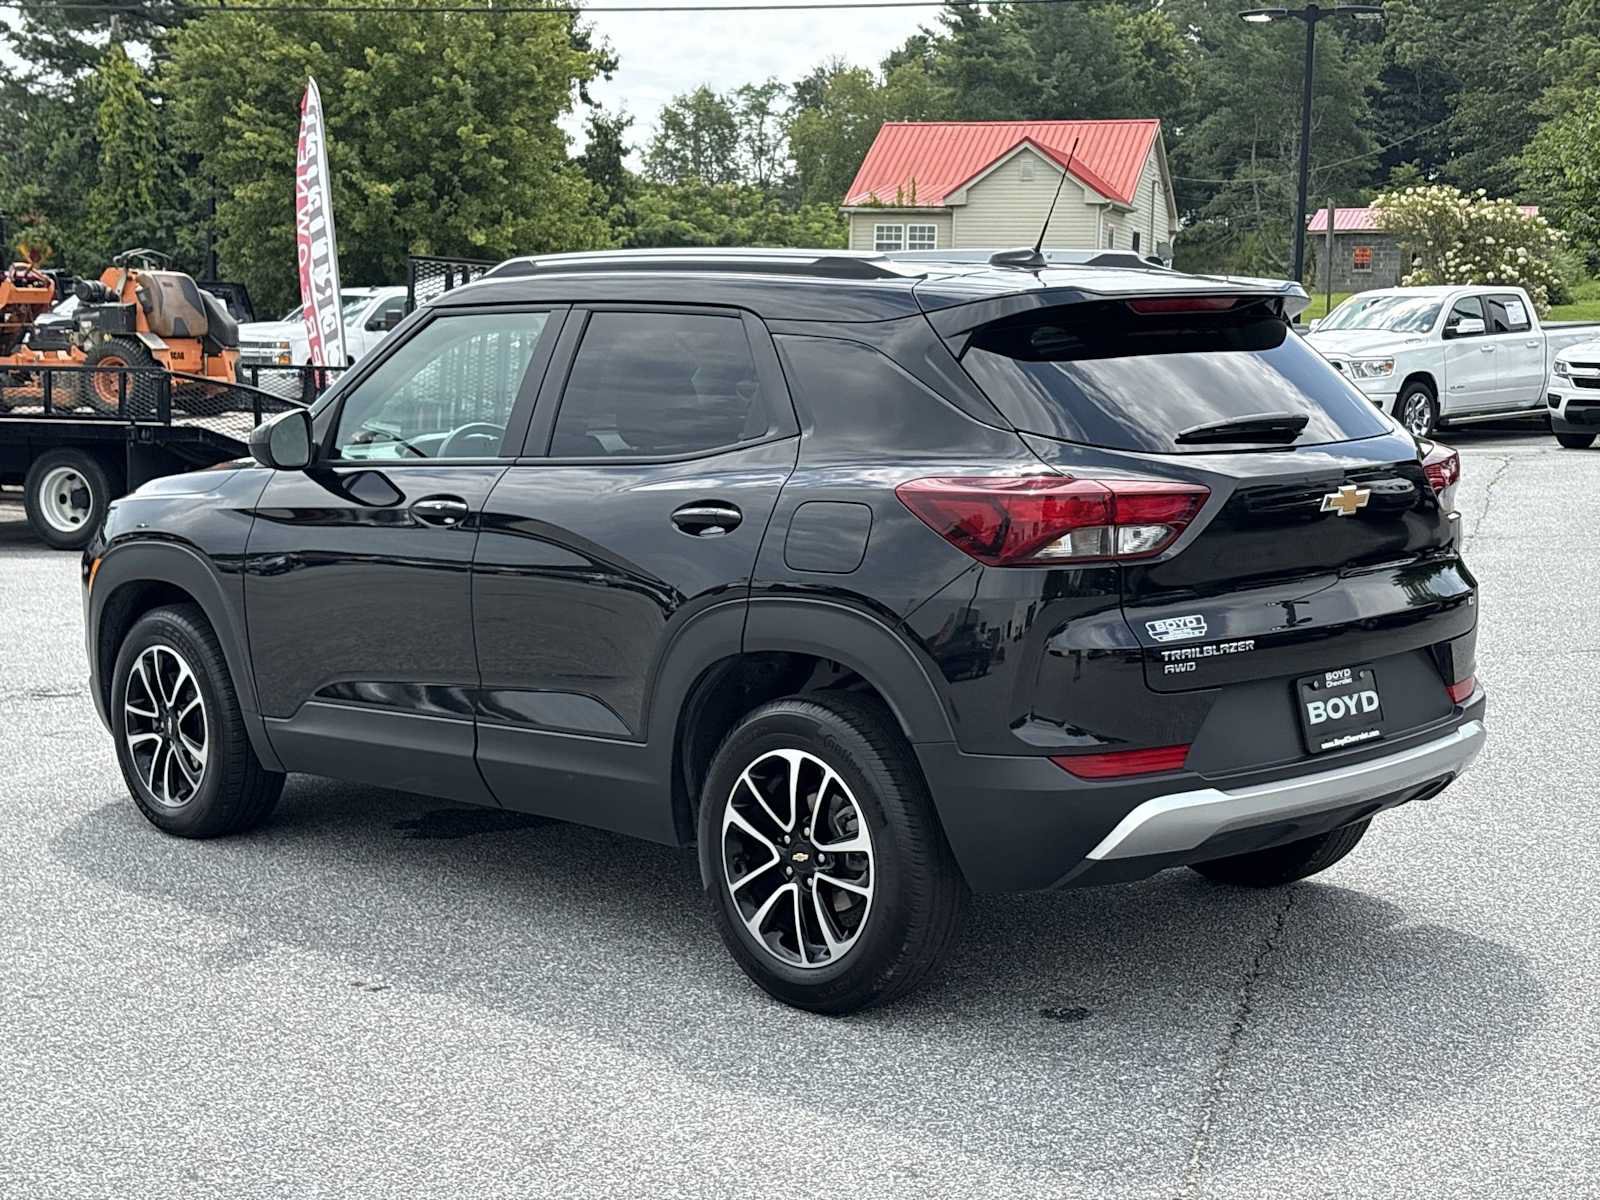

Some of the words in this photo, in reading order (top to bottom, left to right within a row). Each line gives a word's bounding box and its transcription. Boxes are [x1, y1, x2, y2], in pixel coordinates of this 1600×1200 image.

[1155, 617, 1197, 632] BOYD
[1161, 640, 1255, 662] TRAILBLAZER
[1164, 661, 1196, 674] AWD
[1325, 668, 1351, 681] BOYD
[1306, 690, 1380, 725] BOYD
